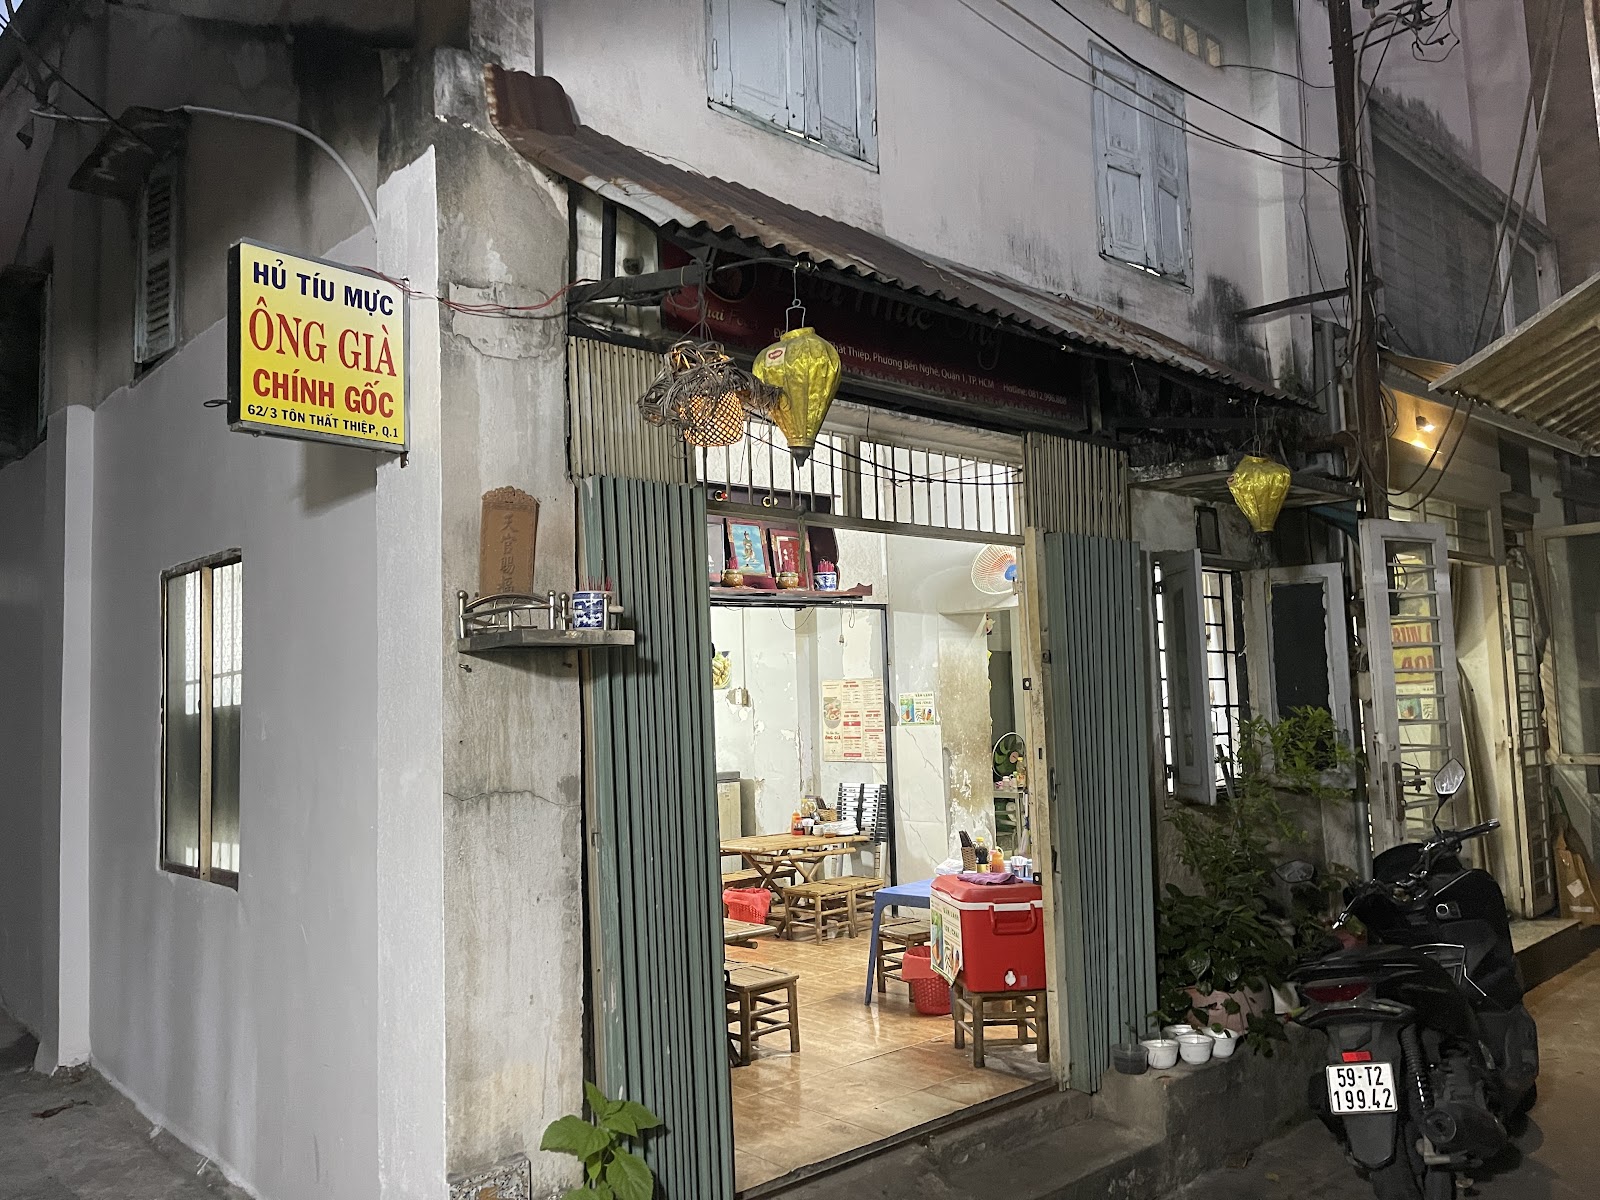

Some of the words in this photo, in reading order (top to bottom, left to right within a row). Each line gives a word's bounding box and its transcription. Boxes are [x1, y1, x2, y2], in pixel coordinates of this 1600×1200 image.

[253, 259, 286, 290] HỦ
[297, 273, 335, 302] TÍU
[344, 286, 393, 316] MỰC
[249, 296, 327, 364] ÔNG
[338, 324, 397, 377] GIÀ
[253, 369, 335, 408] CHÍNH
[344, 381, 394, 418] GỐC
[978, 377, 995, 389] HCM
[247, 404, 278, 419] 62/3
[282, 409, 306, 423] TÔN
[309, 413, 338, 428] THẤT
[343, 419, 379, 436] THIỆP,
[382, 426, 398, 438] Q.1
[1336, 1066, 1384, 1088] 59-T2
[1333, 1087, 1393, 1111] 199.42
